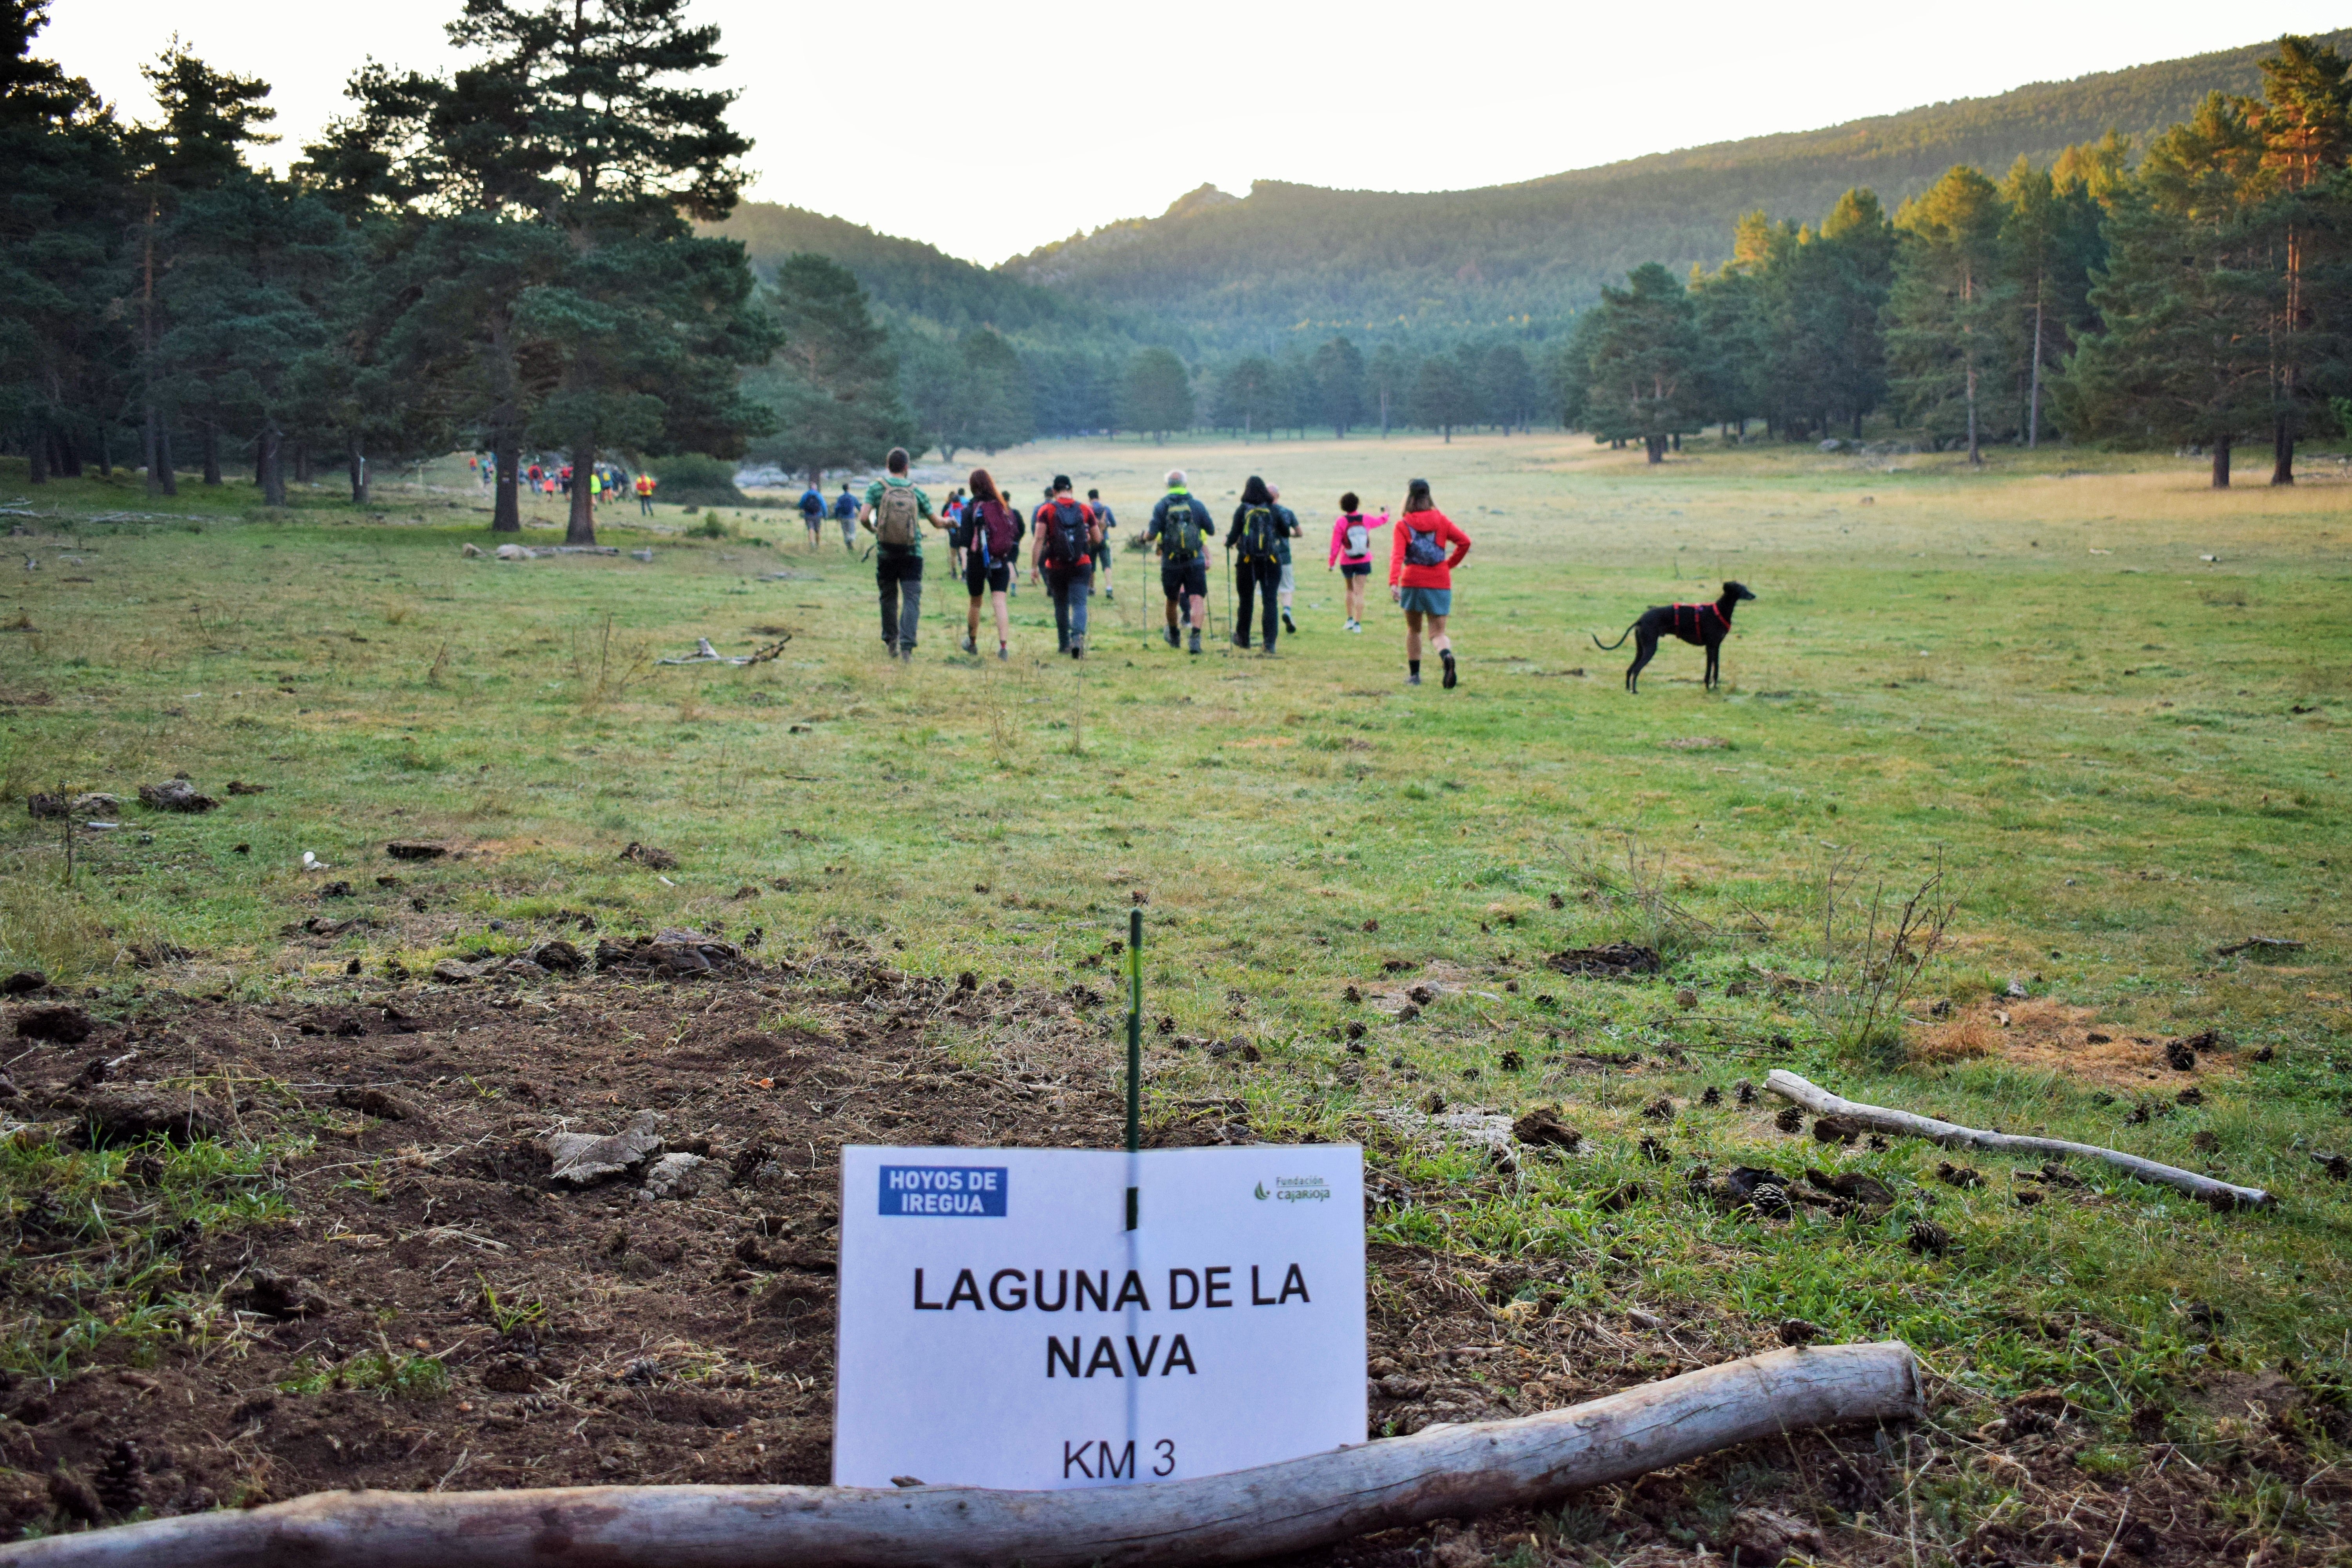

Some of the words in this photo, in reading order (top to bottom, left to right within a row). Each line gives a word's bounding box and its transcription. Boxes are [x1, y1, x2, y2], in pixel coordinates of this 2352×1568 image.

[889, 1171, 963, 1190] HOYOS
[969, 1172, 997, 1190] DE
[1276, 1175, 1324, 1185] Fundación
[902, 1193, 984, 1212] IREGUA
[914, 1268, 1151, 1312] LAGUNA
[1169, 1266, 1233, 1310] DE
[1251, 1263, 1310, 1306] LA
[1047, 1334, 1197, 1378] NAVA
[1063, 1440, 1136, 1479] KM
[1153, 1438, 1176, 1477] 3
